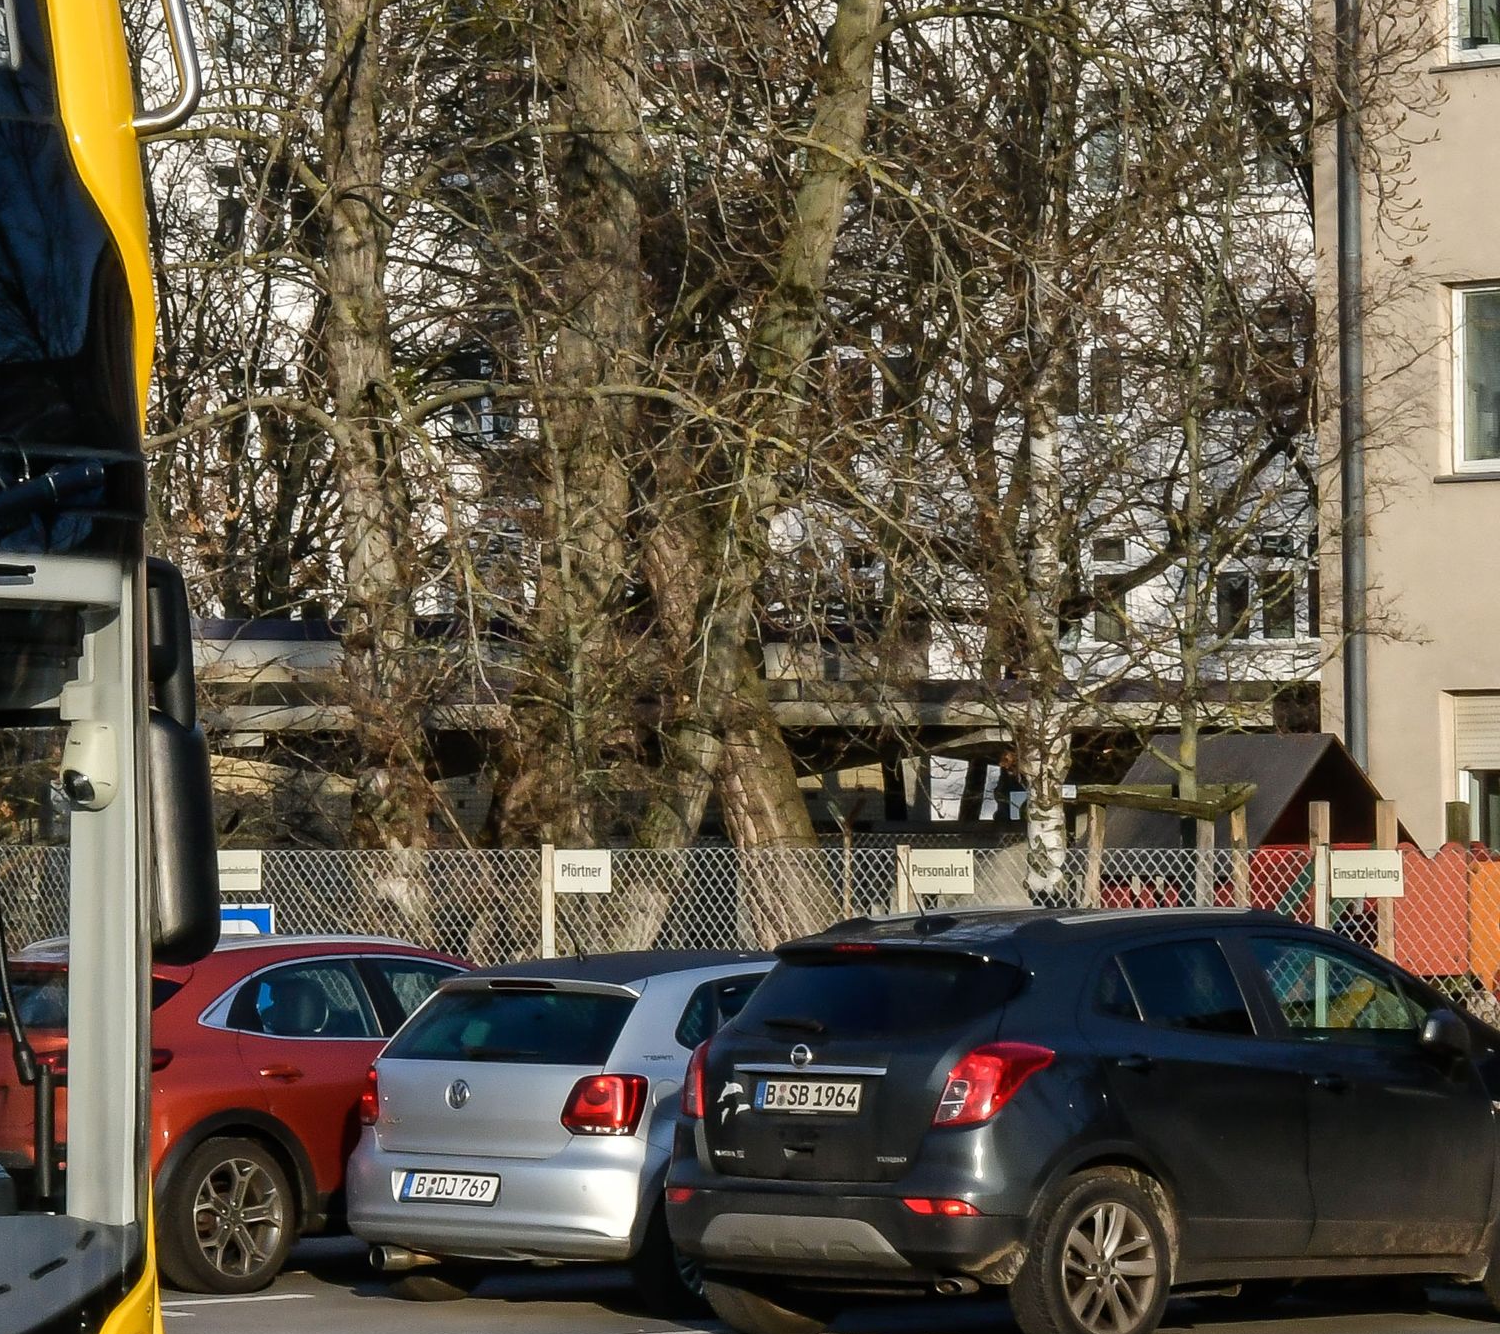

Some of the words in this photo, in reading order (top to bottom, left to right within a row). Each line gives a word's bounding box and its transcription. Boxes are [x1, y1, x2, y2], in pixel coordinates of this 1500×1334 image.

[561, 862, 602, 877] Pförtner
[911, 863, 970, 877] Personalrat
[1333, 867, 1400, 882] Einsatzleitung
[766, 1085, 776, 1106] B
[787, 1085, 810, 1106] SB
[813, 1085, 857, 1108] 1964
[416, 1177, 426, 1194] B
[436, 1177, 457, 1196] DJ
[459, 1178, 490, 1198] 769
